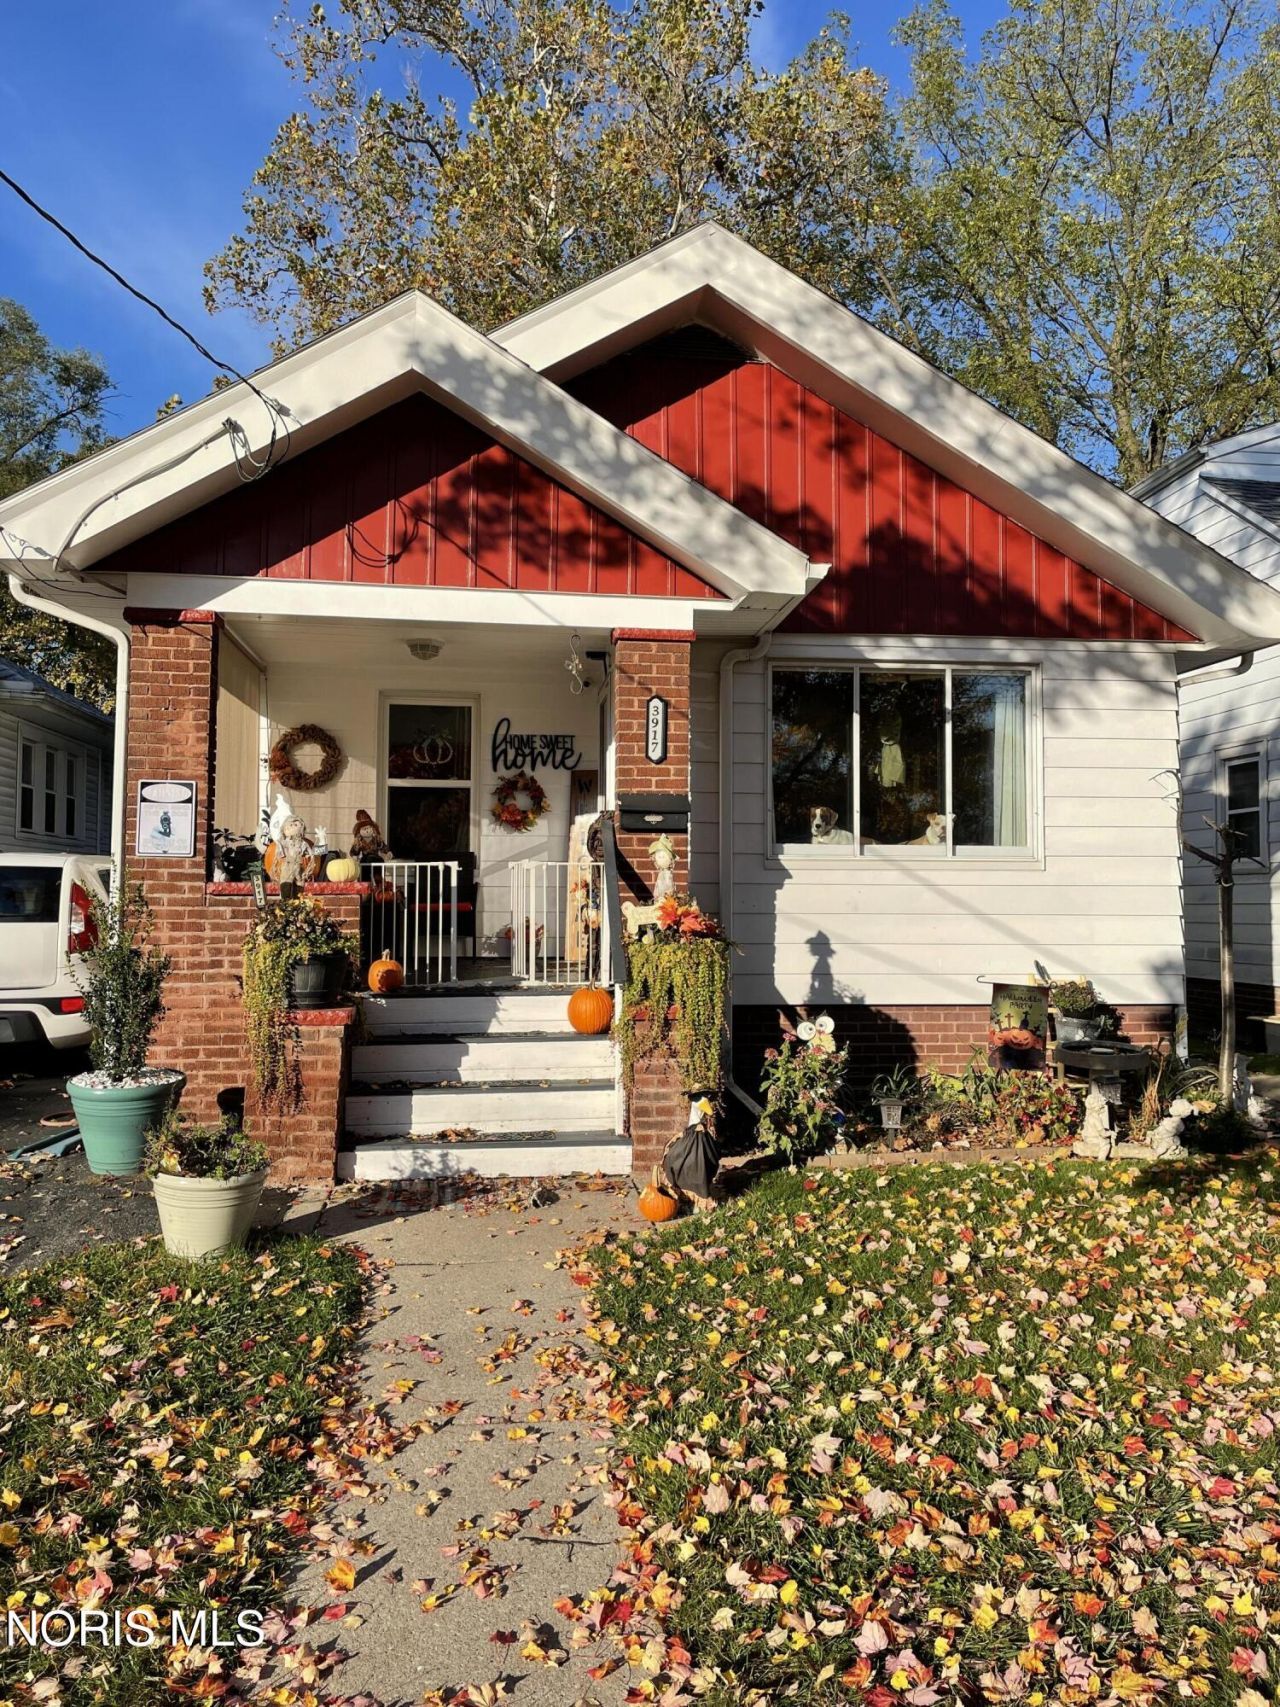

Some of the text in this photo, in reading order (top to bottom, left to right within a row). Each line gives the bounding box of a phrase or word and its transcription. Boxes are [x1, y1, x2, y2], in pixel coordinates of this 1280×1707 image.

[491, 717, 582, 772] home
[506, 734, 576, 750] HOME SWEET
[651, 705, 660, 753] 3917
[1010, 1001, 1033, 1010] PARTY
